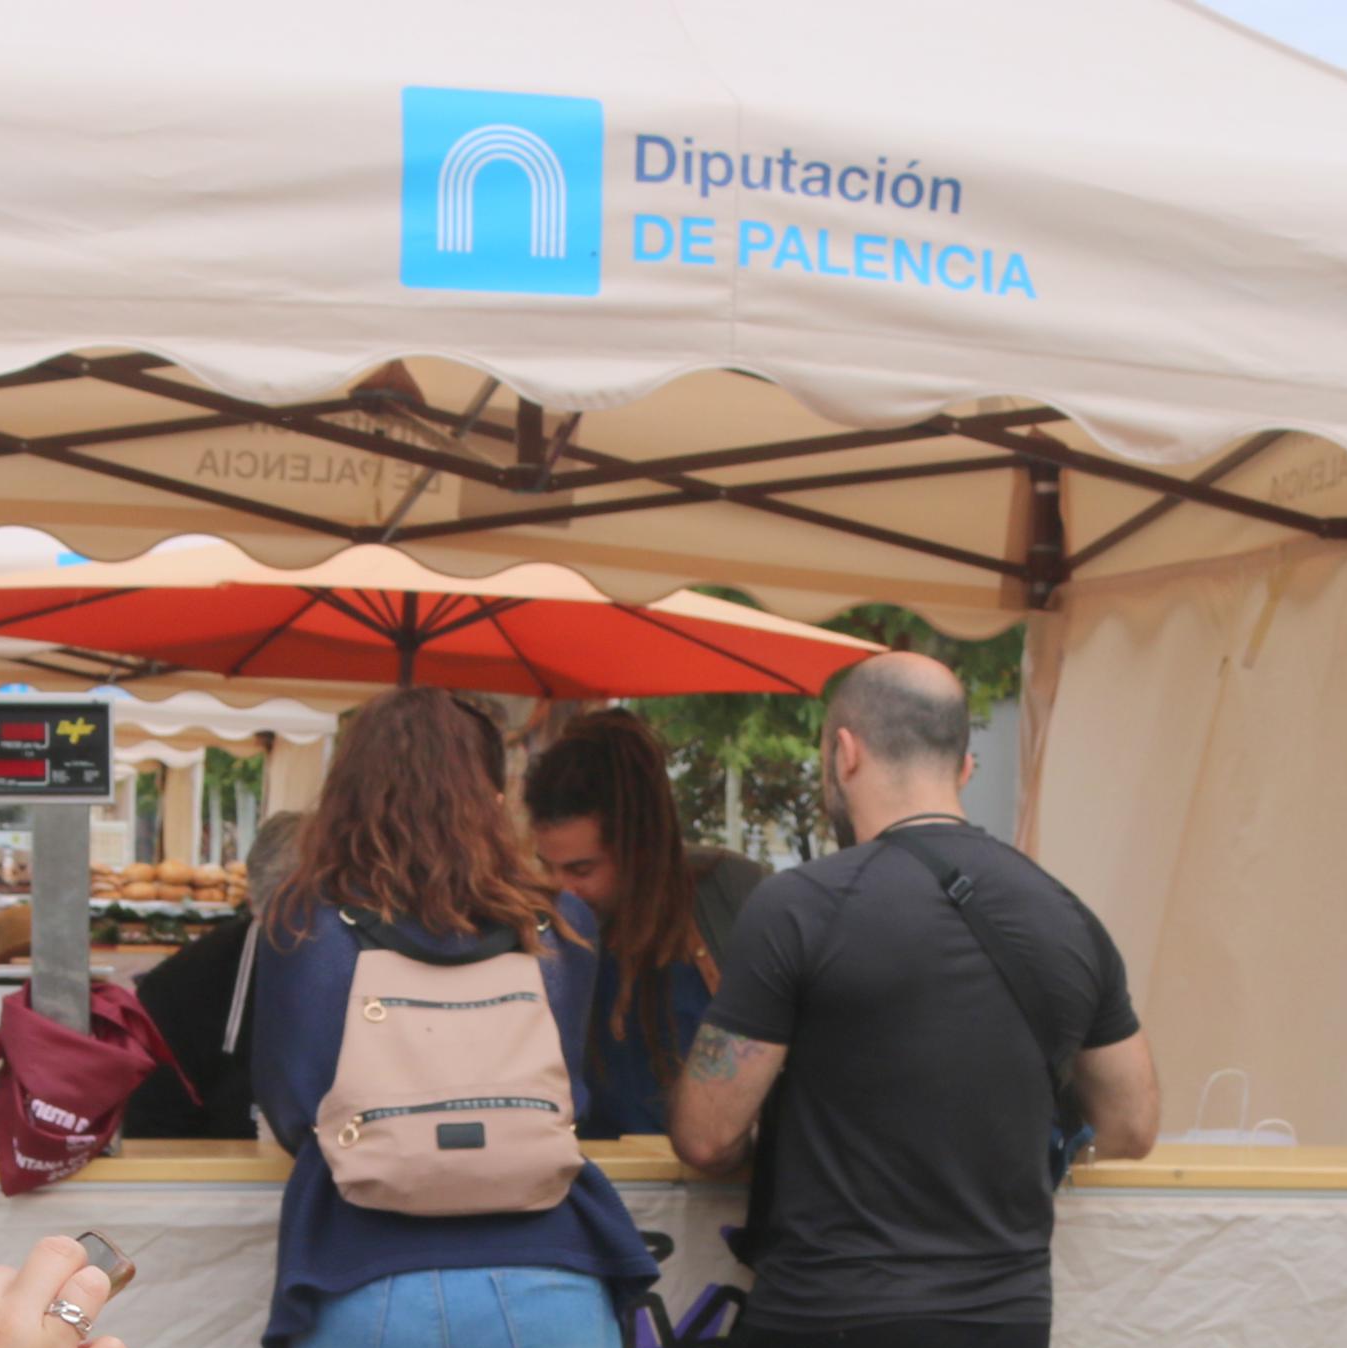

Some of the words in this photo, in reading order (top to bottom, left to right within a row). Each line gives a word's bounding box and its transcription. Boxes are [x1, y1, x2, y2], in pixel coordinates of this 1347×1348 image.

[633, 133, 963, 214] Diputación
[631, 212, 716, 266] DE
[736, 220, 1038, 299] PALENCIA
